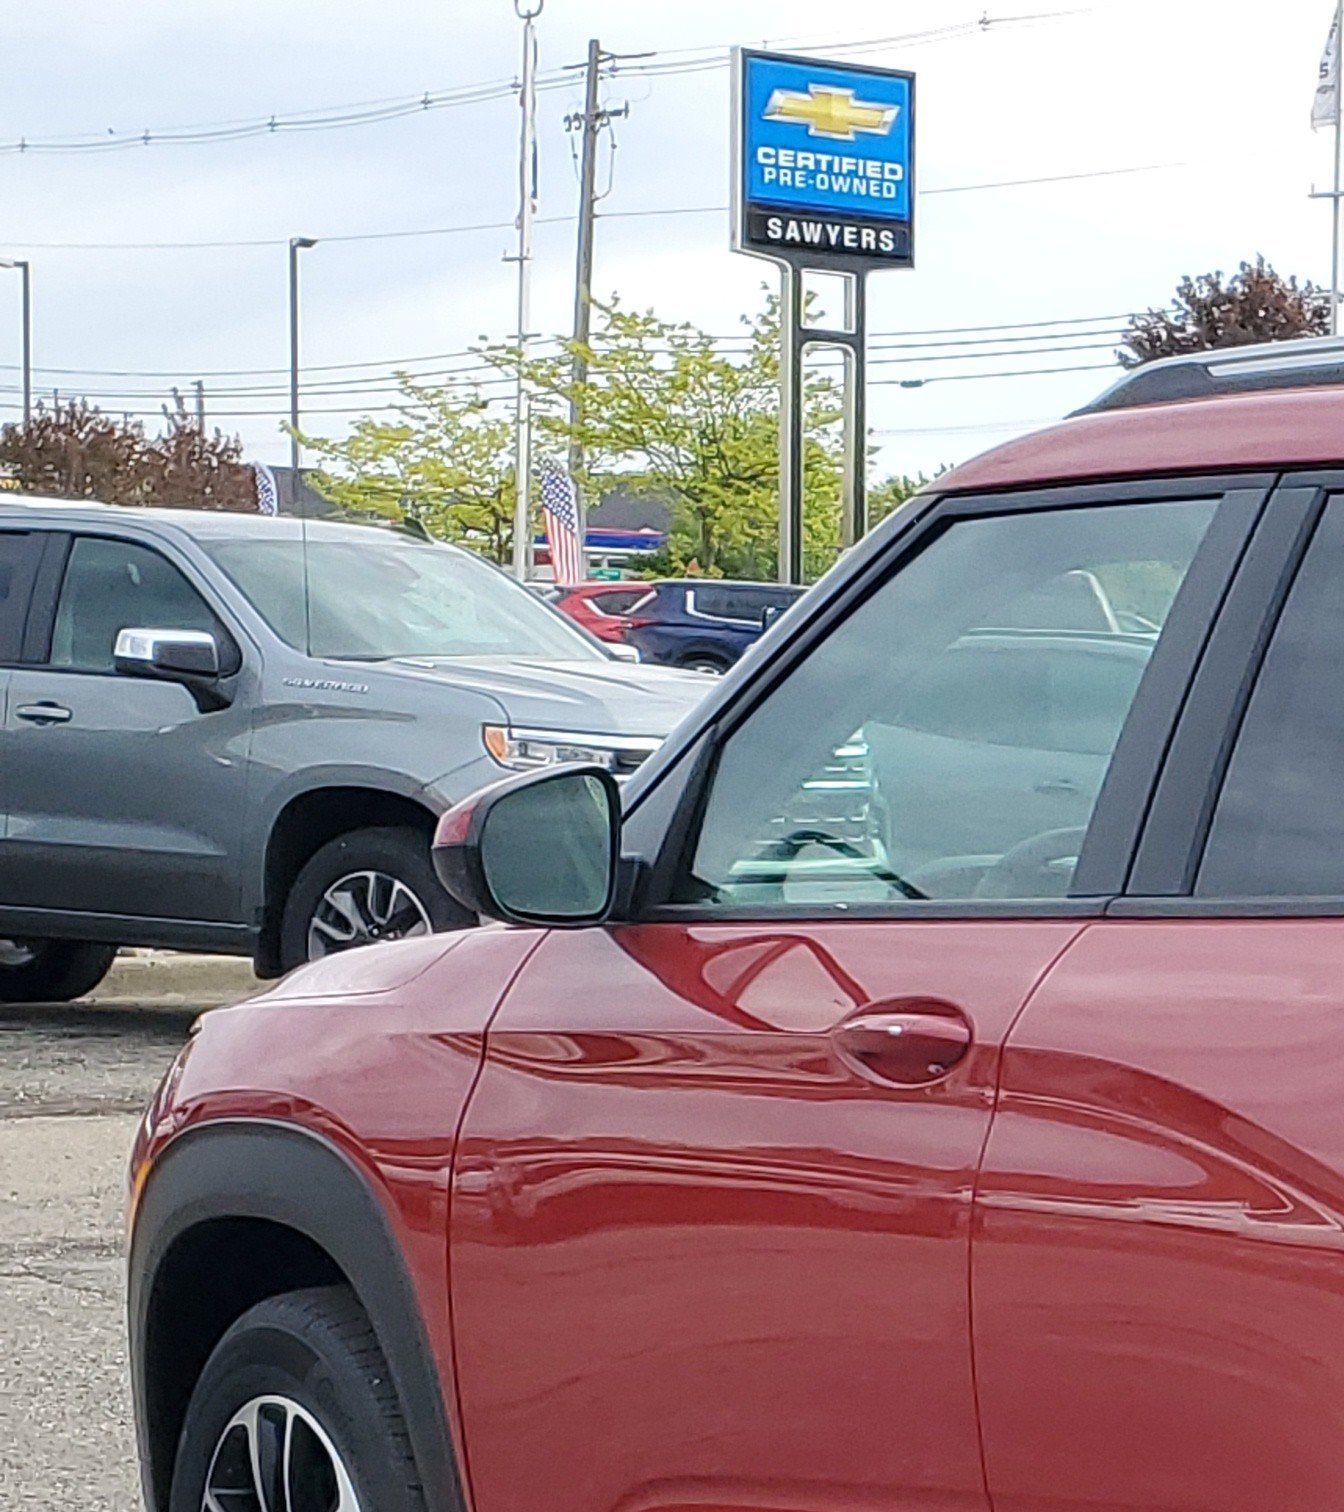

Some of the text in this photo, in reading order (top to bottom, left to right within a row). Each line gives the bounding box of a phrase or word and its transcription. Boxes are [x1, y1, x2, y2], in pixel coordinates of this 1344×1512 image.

[757, 147, 903, 180] CERTIFIED
[763, 167, 896, 198] PRE-OWNED
[767, 218, 895, 250] SAWYERS
